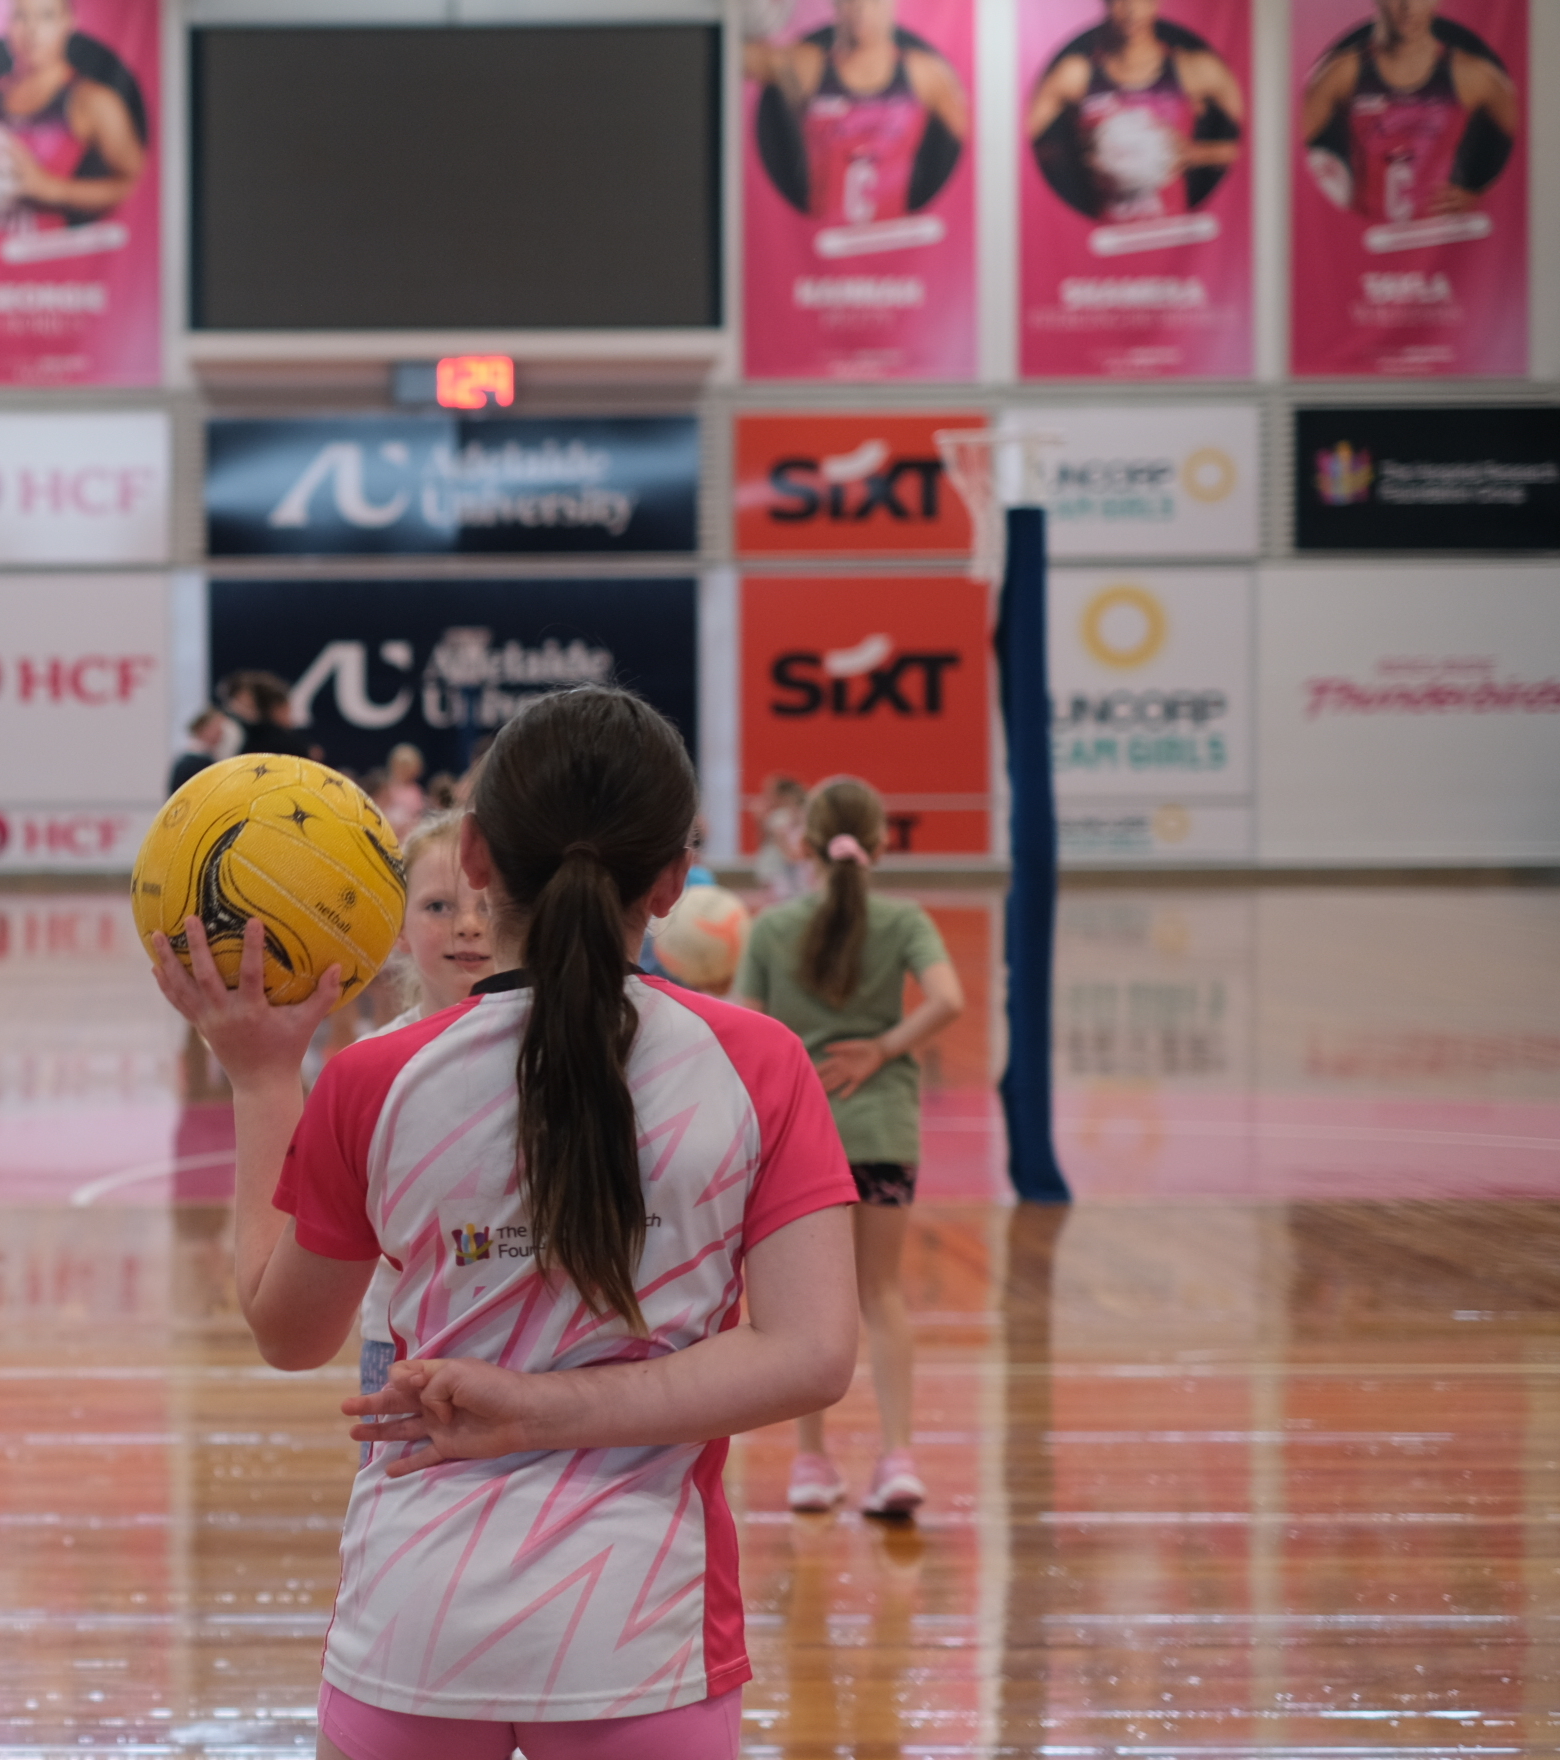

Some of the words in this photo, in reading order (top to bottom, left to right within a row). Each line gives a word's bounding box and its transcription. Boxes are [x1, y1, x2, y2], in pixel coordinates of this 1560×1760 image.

[425, 441, 610, 480] Adelaide
[1046, 460, 1174, 490] UNCORP
[17, 463, 158, 517] HCF
[424, 484, 634, 532] University
[17, 654, 158, 706] HCF
[1051, 692, 1229, 729] UNCORP
[1051, 735, 1118, 768] EAM
[1128, 735, 1228, 768] GIRLS
[23, 816, 131, 856] HCF
[314, 900, 352, 934] netball
[496, 1225, 528, 1239] The
